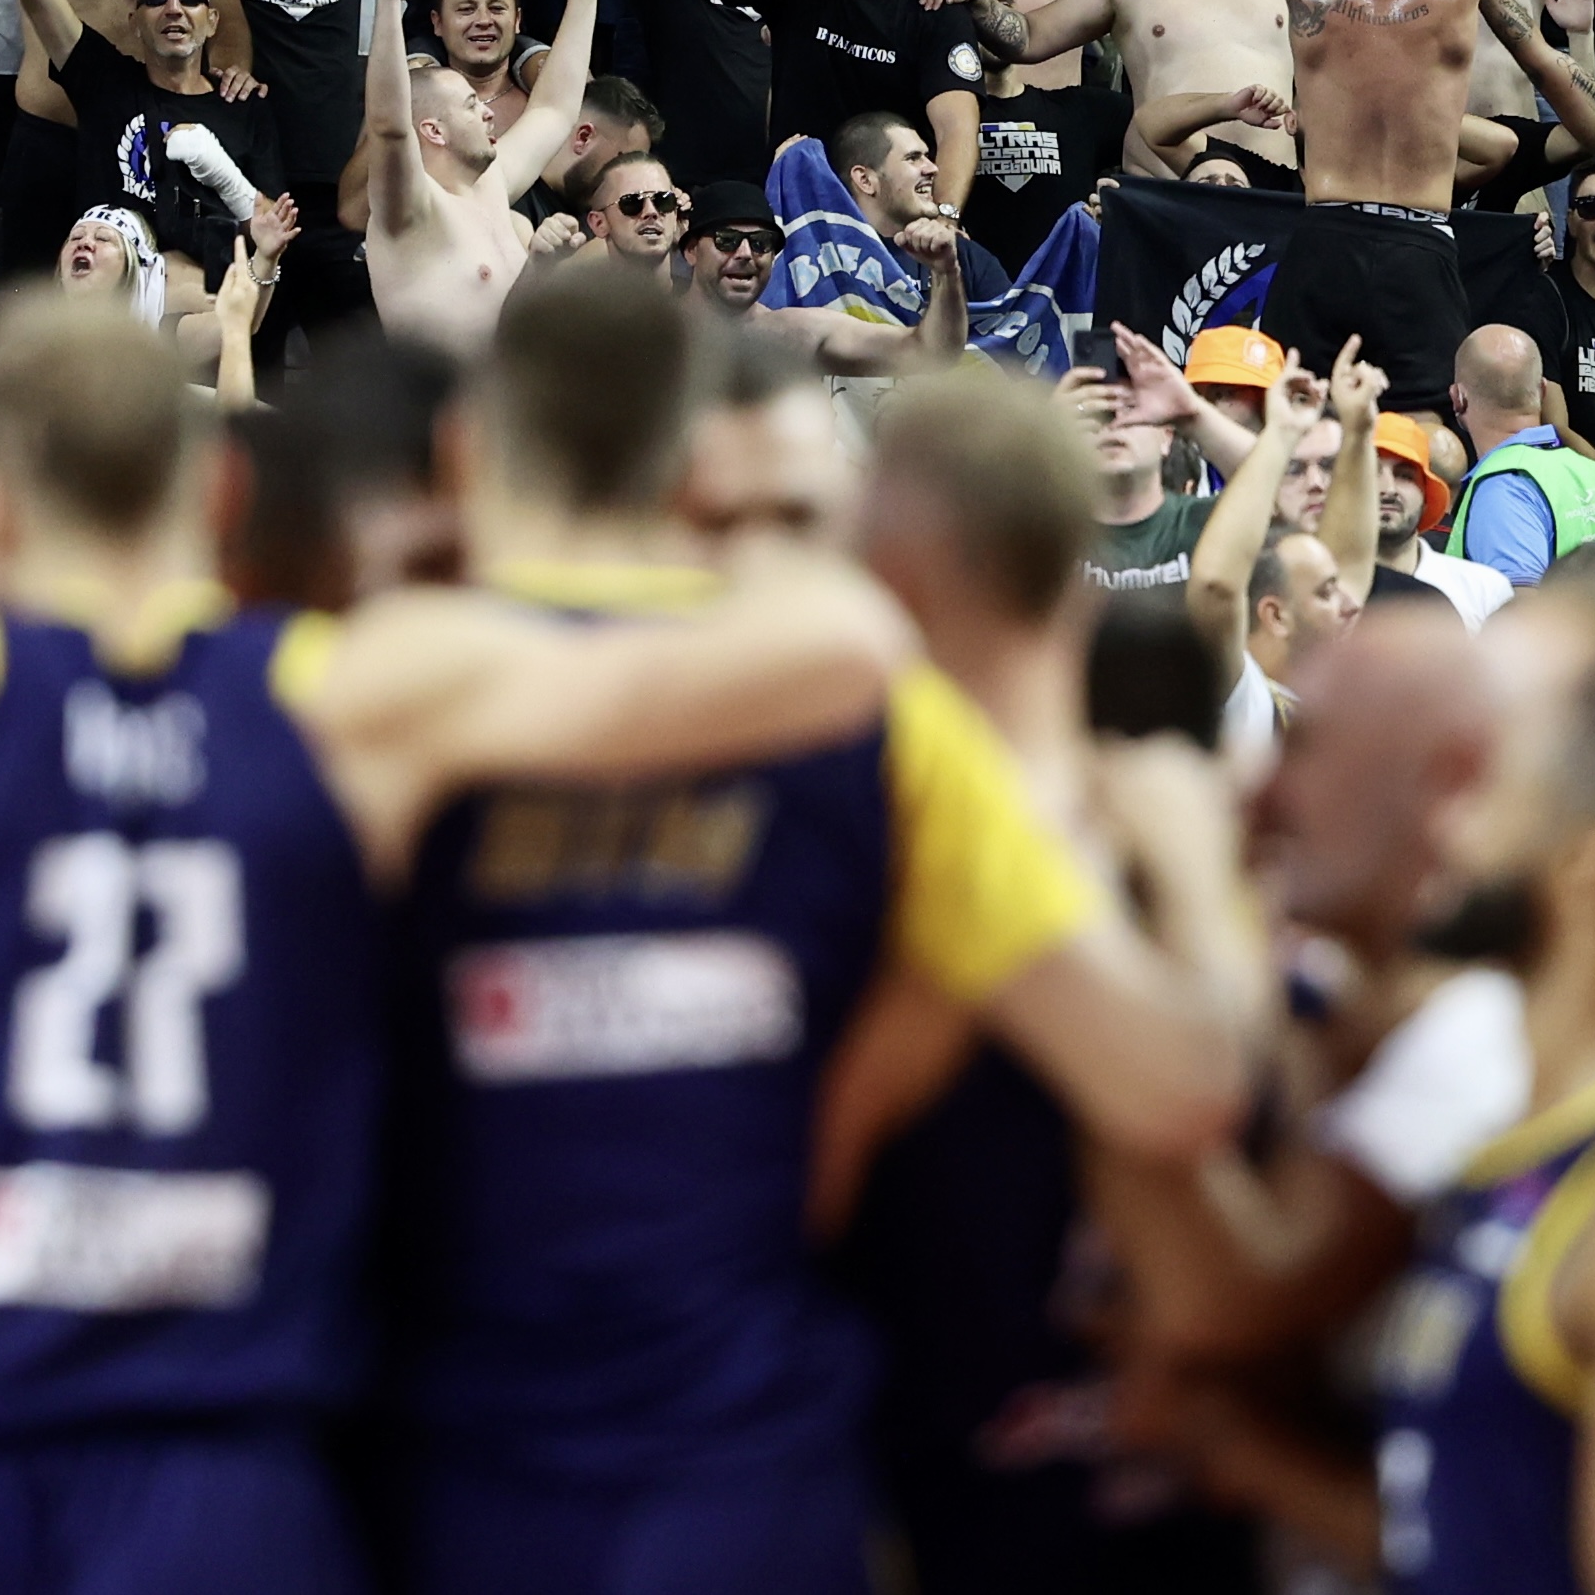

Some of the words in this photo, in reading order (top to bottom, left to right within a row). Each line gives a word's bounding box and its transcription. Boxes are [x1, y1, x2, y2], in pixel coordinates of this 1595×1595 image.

[978, 131, 1059, 149] LTRAS
[1083, 551, 1190, 591] hummel
[7, 828, 247, 1137] 27
